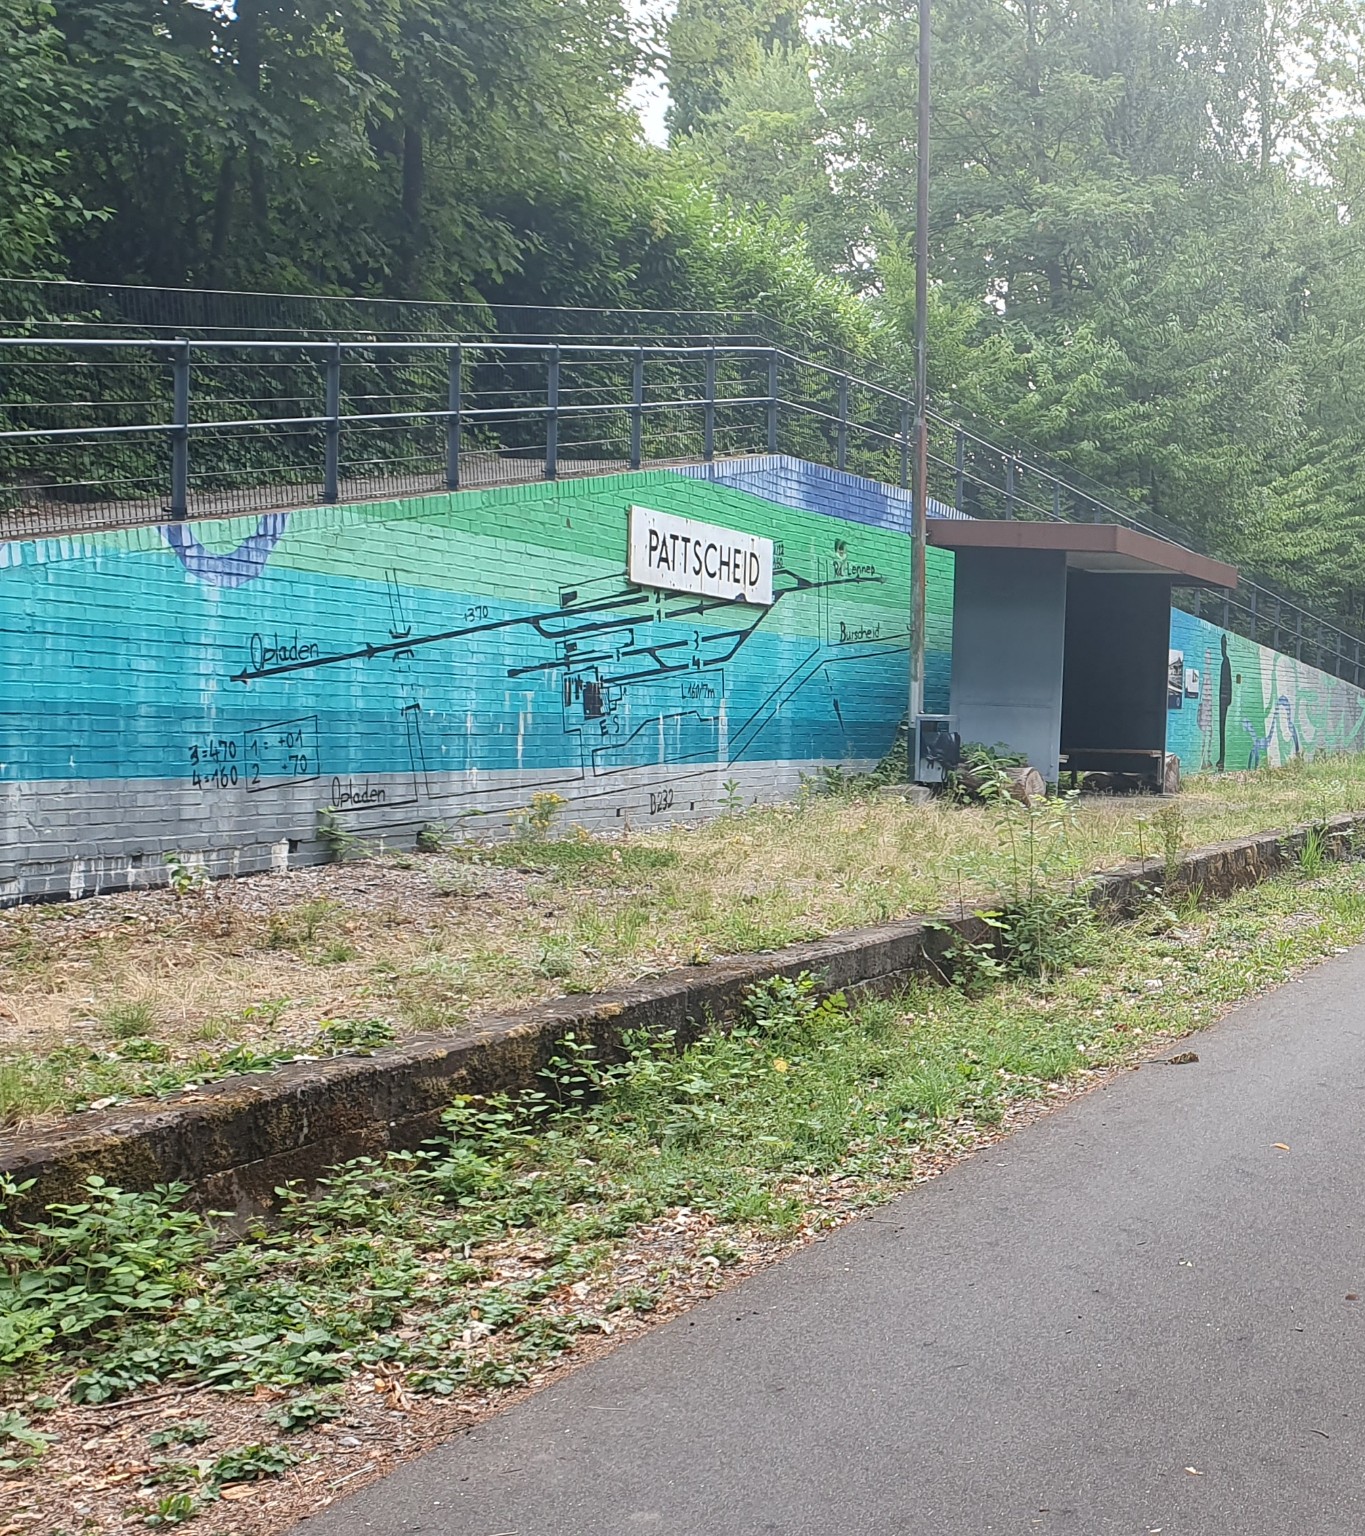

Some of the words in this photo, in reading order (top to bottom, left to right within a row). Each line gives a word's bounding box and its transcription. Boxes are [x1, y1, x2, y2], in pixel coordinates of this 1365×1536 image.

[648, 528, 760, 587] PATTSCHEID
[840, 621, 880, 642] Burscheid
[250, 629, 319, 671] Opladen
[251, 763, 261, 784] 2
[332, 776, 386, 808] Opladen
[650, 788, 674, 816] B232
